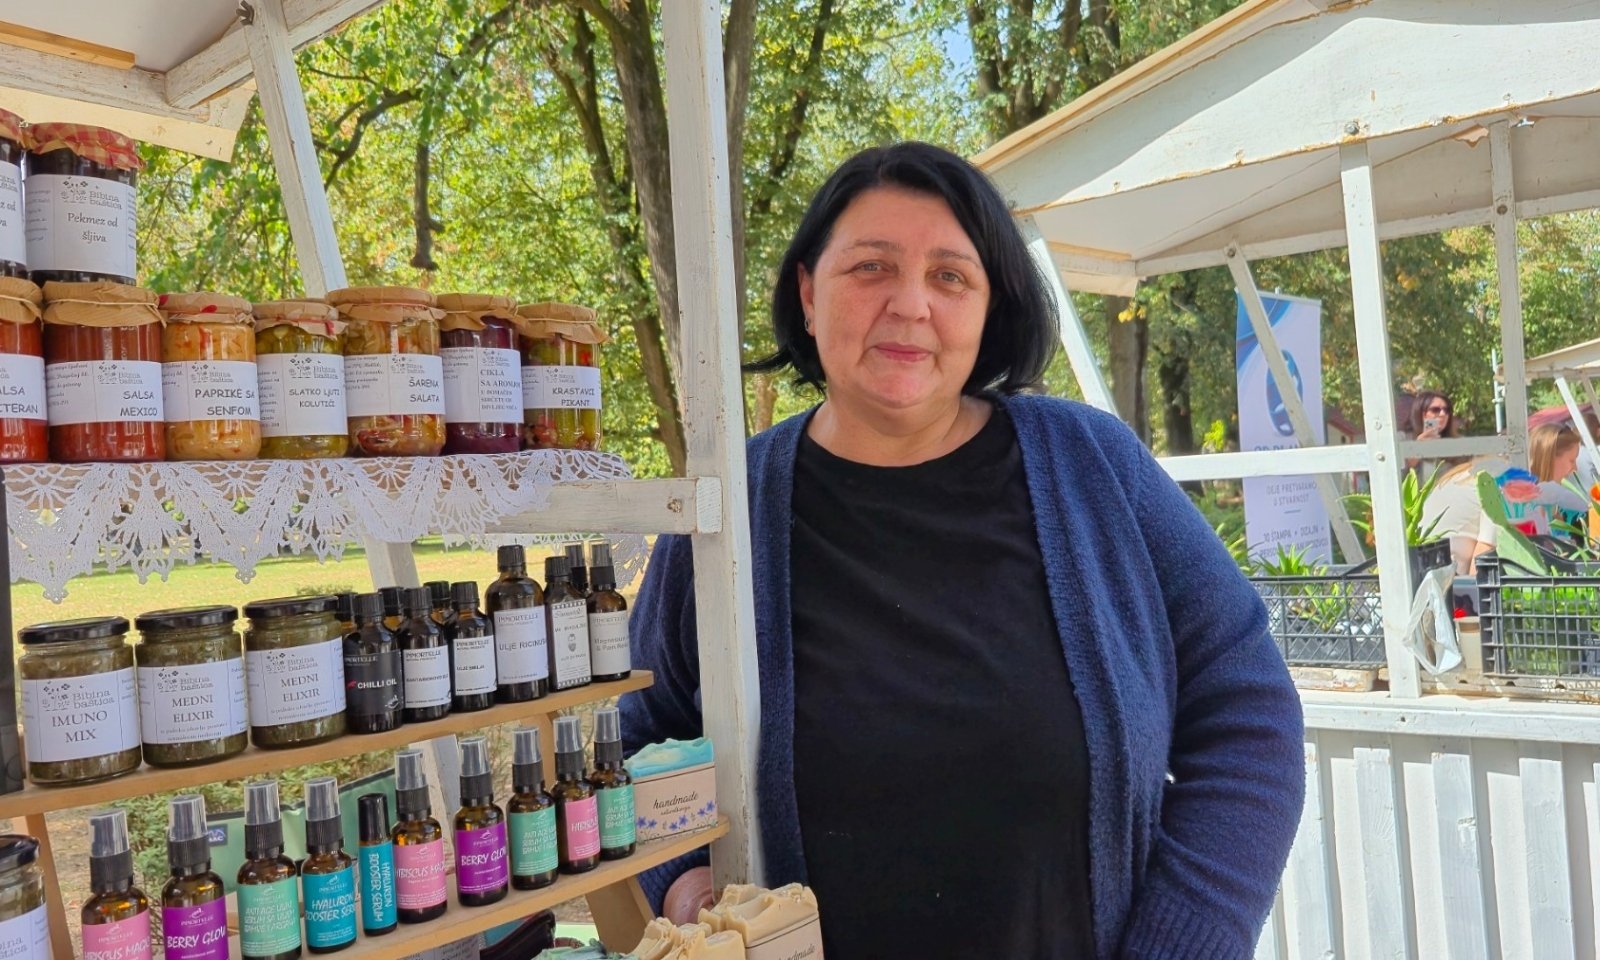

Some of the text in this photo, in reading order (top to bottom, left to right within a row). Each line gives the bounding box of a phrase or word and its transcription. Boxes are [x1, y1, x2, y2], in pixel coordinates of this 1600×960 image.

[68, 212, 118, 228] Pekmez od
[82, 231, 107, 244] šljiva
[408, 376, 439, 388] ŠARENA
[123, 390, 154, 400] SALSA
[195, 388, 255, 399] PAPRIKE SA
[289, 388, 340, 397] SLATKO LJUTI
[410, 394, 440, 403] SALATA
[561, 399, 590, 407] PIKANT
[120, 406, 158, 417] MEXICO
[207, 406, 252, 416] SENFOM
[499, 642, 517, 652] ULJE
[281, 673, 319, 688] MEDNI
[357, 678, 398, 689] CHILLI OIL
[72, 689, 111, 701] Bibina
[172, 694, 213, 708] MEDNI
[283, 688, 321, 703] ELIXIR
[52, 710, 108, 727] IMUNO
[173, 710, 214, 723] ELIXIR
[65, 729, 98, 743] MIX
[653, 791, 699, 810] handmade
[461, 853, 489, 866] BERRY
[369, 853, 384, 922] BOOSTER SERUM
[381, 862, 393, 908] HYALURON
[167, 934, 200, 949] BERRY
